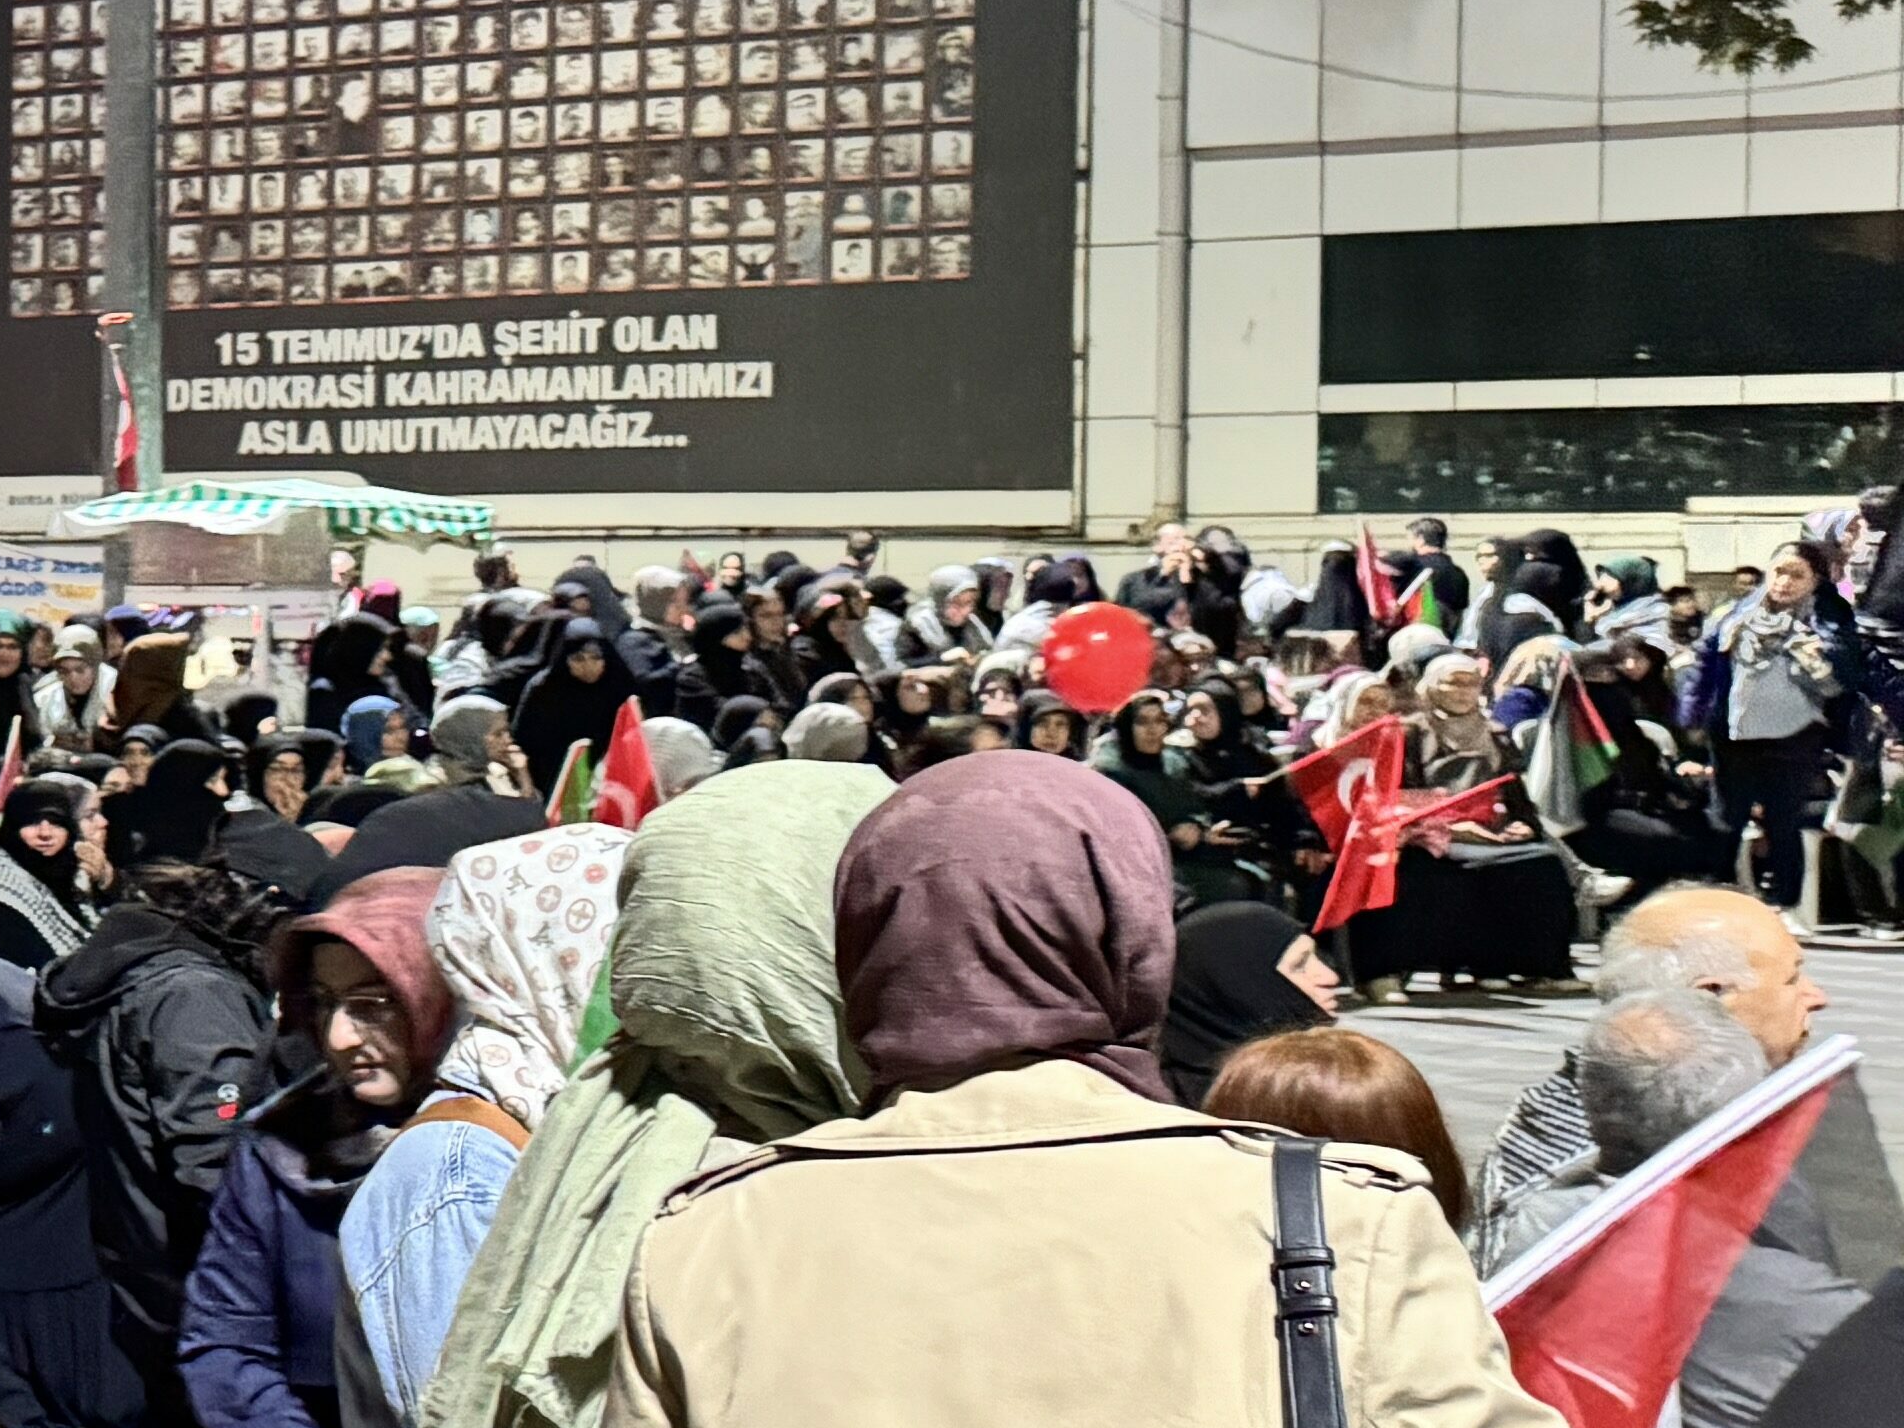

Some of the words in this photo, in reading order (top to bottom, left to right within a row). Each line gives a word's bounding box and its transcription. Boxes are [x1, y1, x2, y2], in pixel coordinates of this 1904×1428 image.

[214, 331, 261, 366] 15
[494, 309, 606, 366] ŞEHİT
[613, 314, 718, 352] OLAN
[166, 365, 376, 412] DEMOKRASİ
[385, 360, 773, 407] KAHRAMANLARIMIZI
[237, 420, 334, 456] ASLA
[341, 404, 689, 455] UNUTMAYACAĞIZ...
